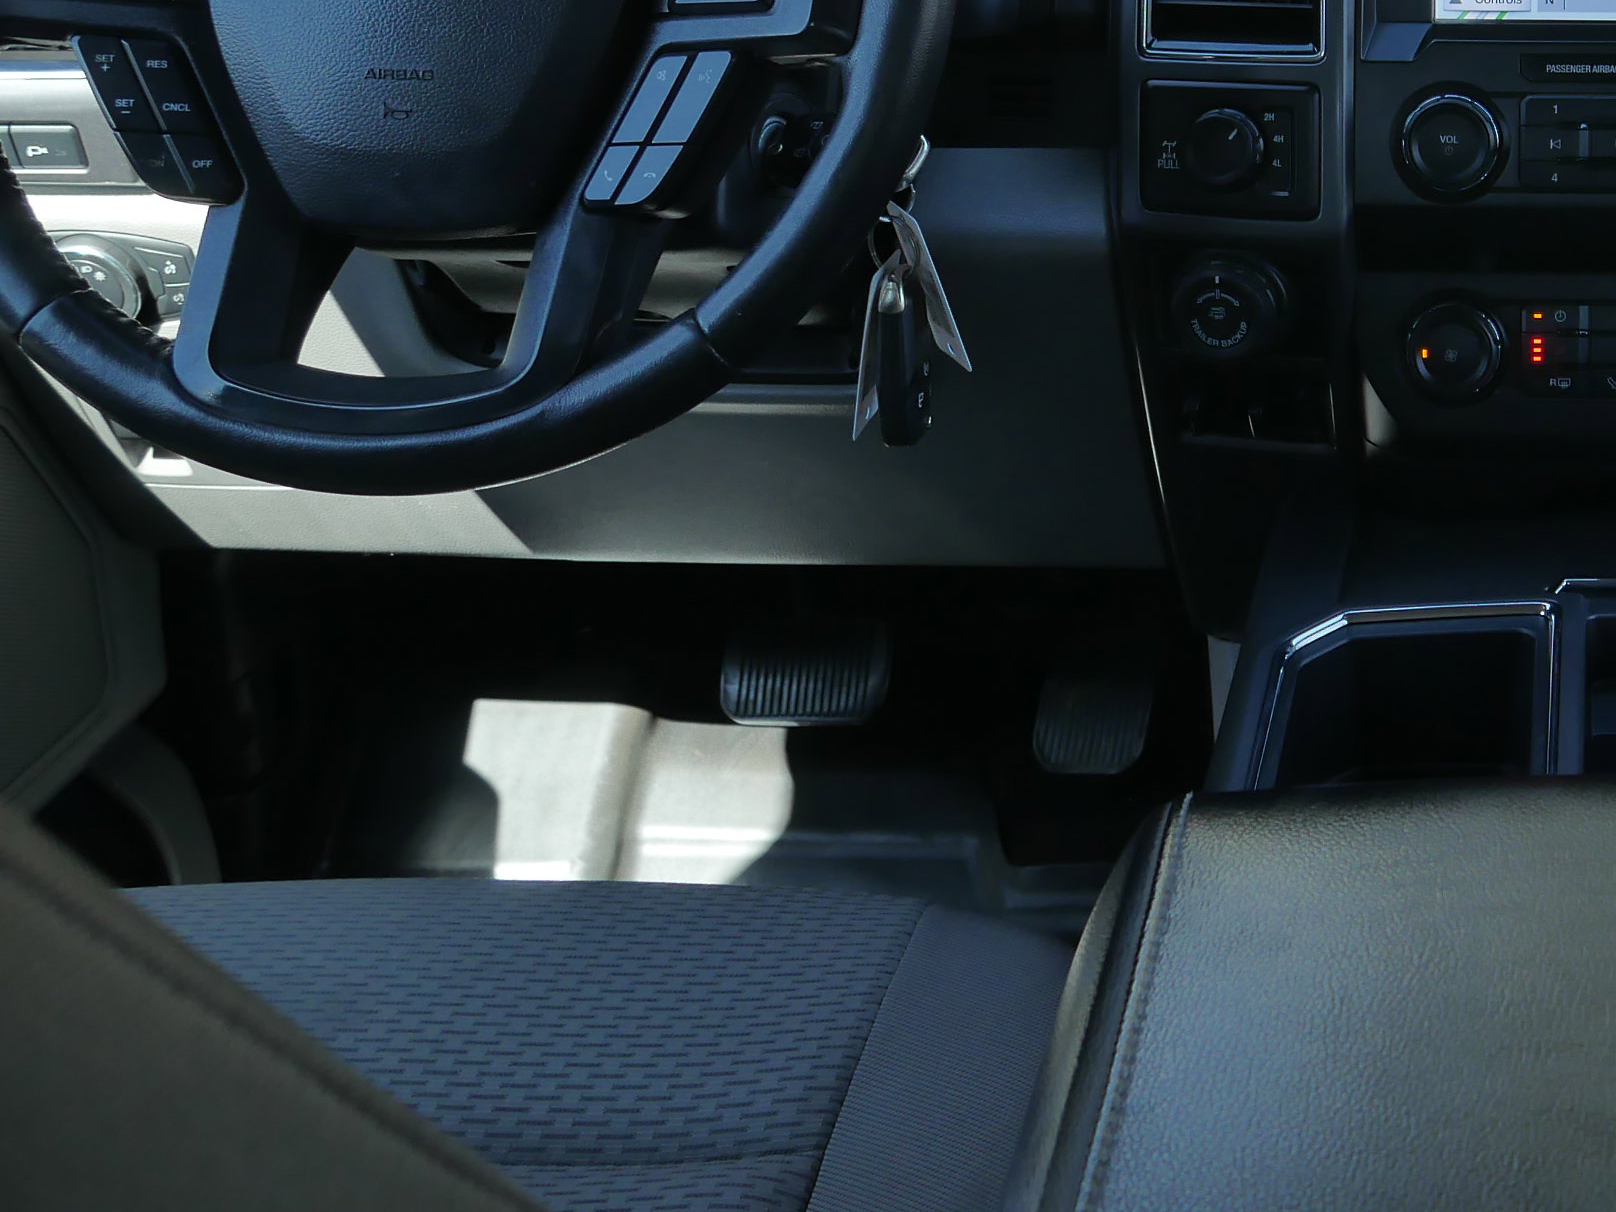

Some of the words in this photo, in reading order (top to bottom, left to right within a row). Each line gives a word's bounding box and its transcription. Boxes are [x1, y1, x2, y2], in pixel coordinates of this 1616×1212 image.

[95, 54, 115, 62] SET
[146, 60, 168, 68] RES
[1546, 64, 1591, 74] PASSENGER
[363, 68, 435, 82] AIRBAG
[115, 99, 135, 108] SET
[162, 103, 191, 112] CNCL
[1264, 113, 1275, 121] 2H
[1440, 135, 1459, 144] VOL
[192, 159, 213, 168] OFF
[1158, 159, 1180, 169] PULL
[1551, 173, 1559, 182] 4
[1191, 318, 1219, 346] TRAILER
[1221, 321, 1248, 347] BACKUP
